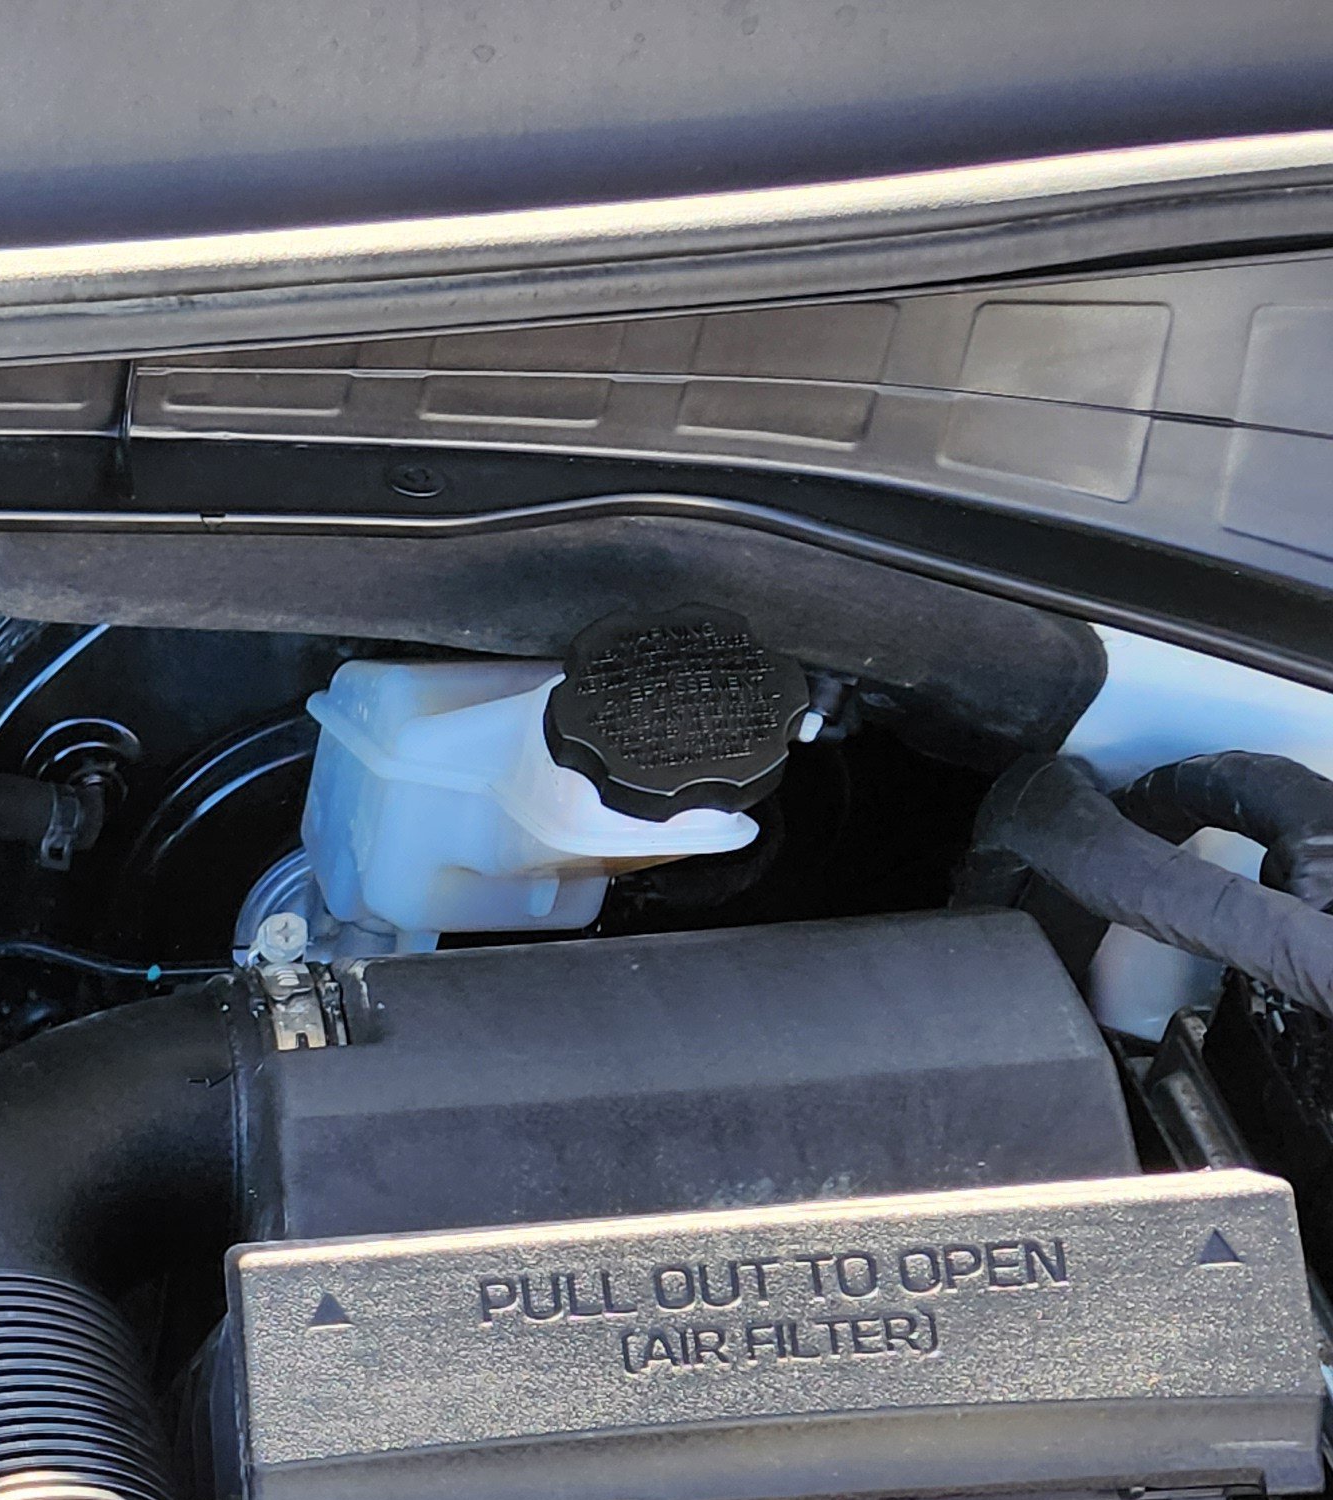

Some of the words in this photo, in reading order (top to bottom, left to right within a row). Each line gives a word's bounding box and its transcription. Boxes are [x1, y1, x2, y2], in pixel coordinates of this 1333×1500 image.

[479, 1270, 638, 1327] PULL
[651, 1256, 781, 1313] OUT
[793, 1248, 880, 1303] TO
[897, 1236, 1070, 1297] OPEN
